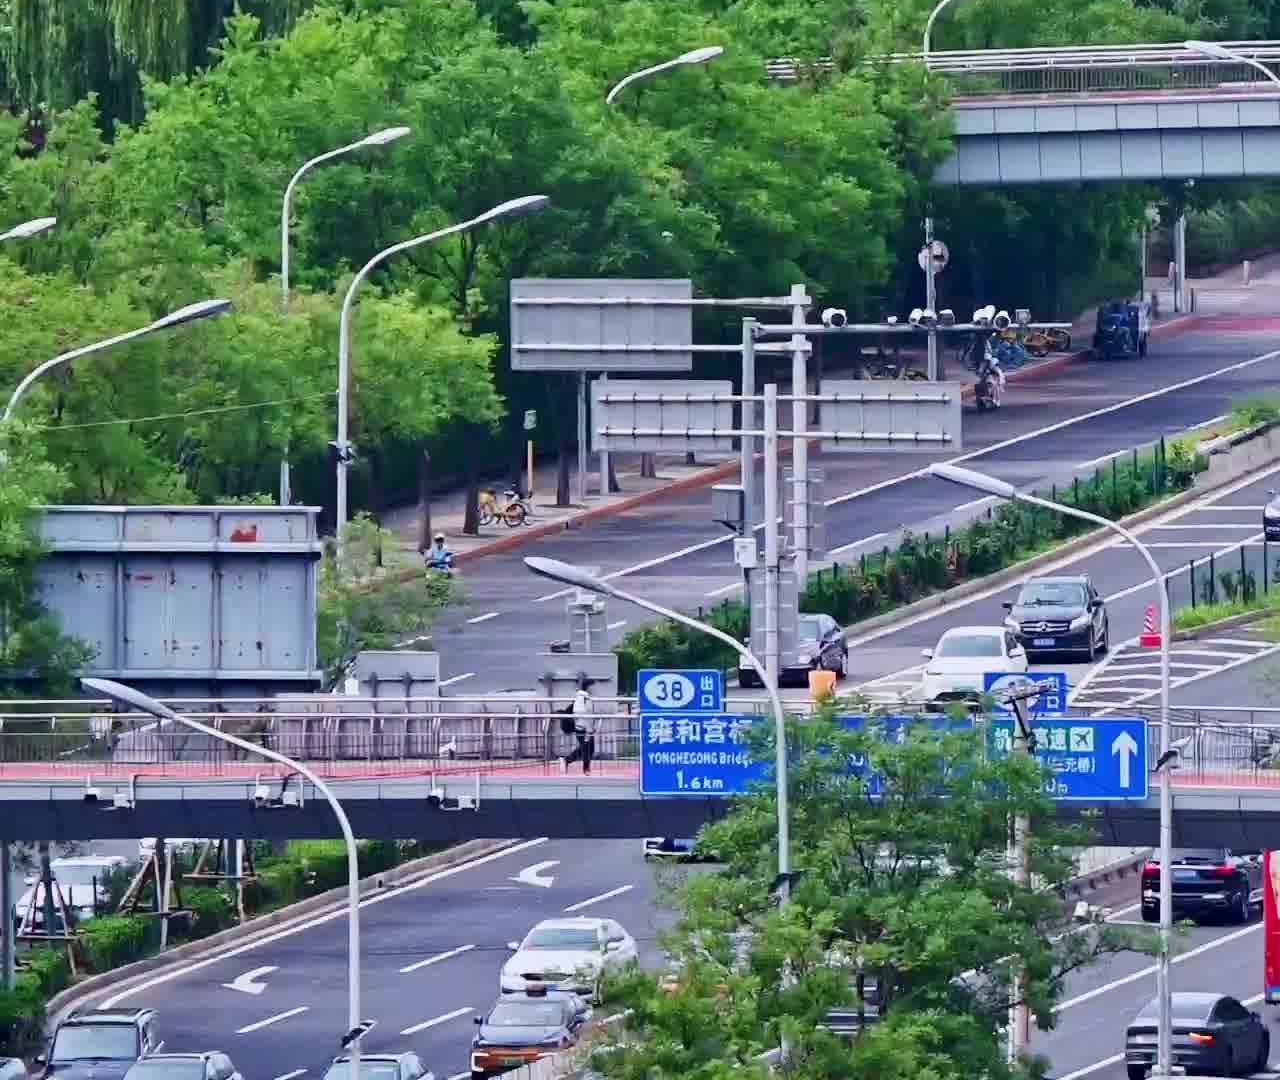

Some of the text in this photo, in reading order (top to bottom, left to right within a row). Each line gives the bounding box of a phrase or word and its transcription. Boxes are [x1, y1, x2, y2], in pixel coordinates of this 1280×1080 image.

[656, 680, 683, 701] 38
[700, 675, 714, 707] 出口
[994, 727, 1067, 751] 机高速
[647, 751, 718, 766] YONGHEGONG
